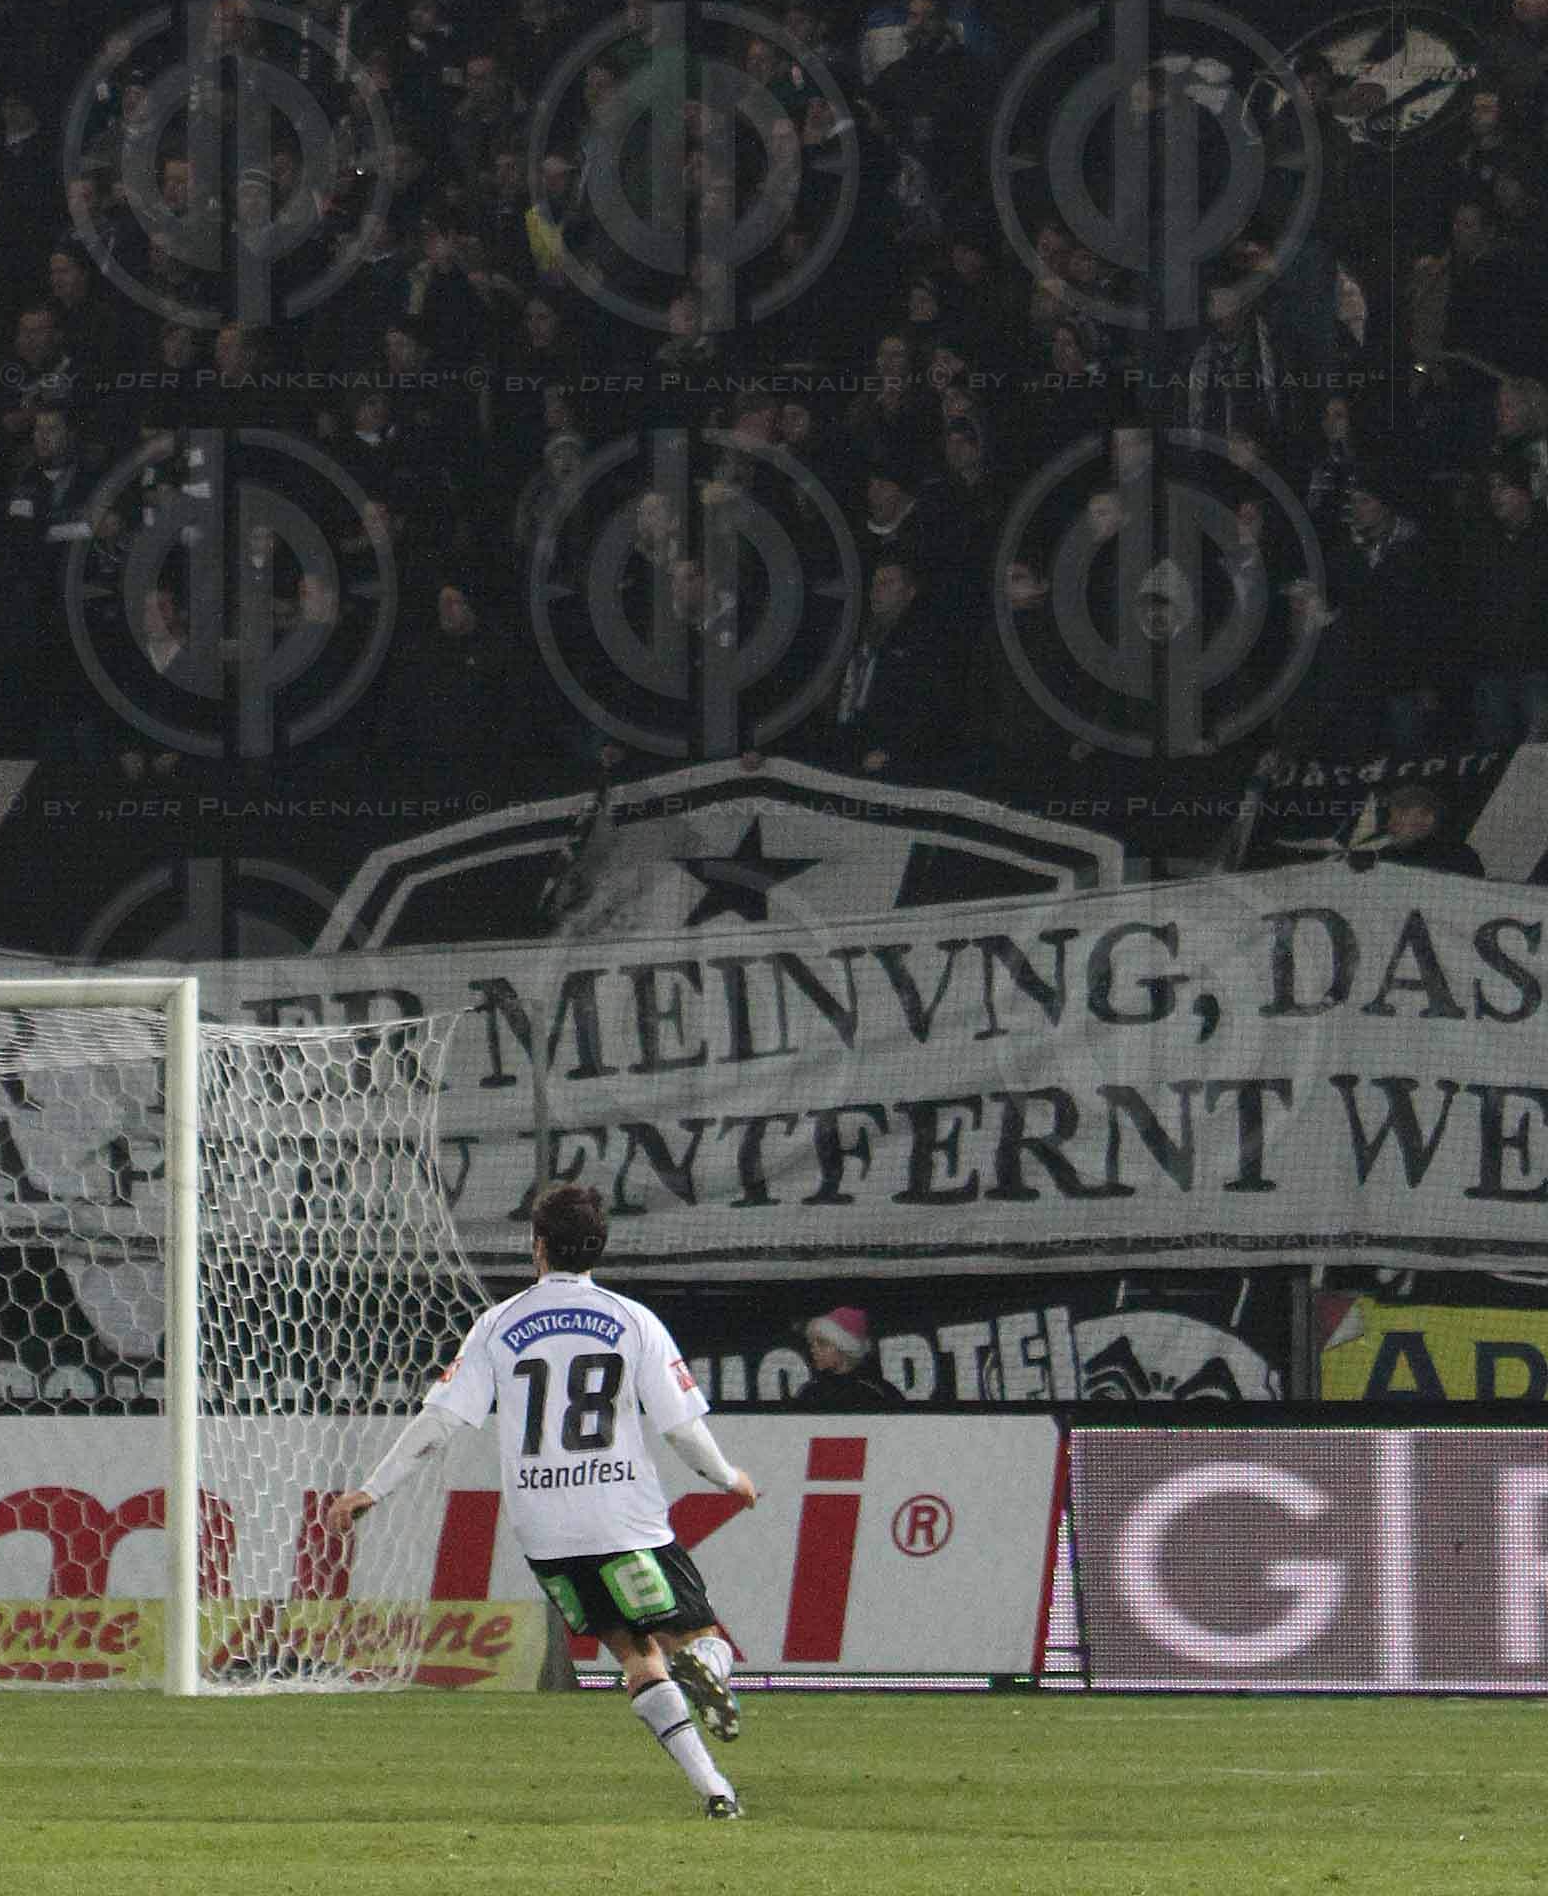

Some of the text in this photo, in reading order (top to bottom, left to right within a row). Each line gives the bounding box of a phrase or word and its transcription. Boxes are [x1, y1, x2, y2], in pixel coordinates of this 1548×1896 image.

[1259, 907, 1544, 1023] DAS
[506, 1313, 620, 1348] PUNTIGAMER
[513, 1352, 624, 1457] 18
